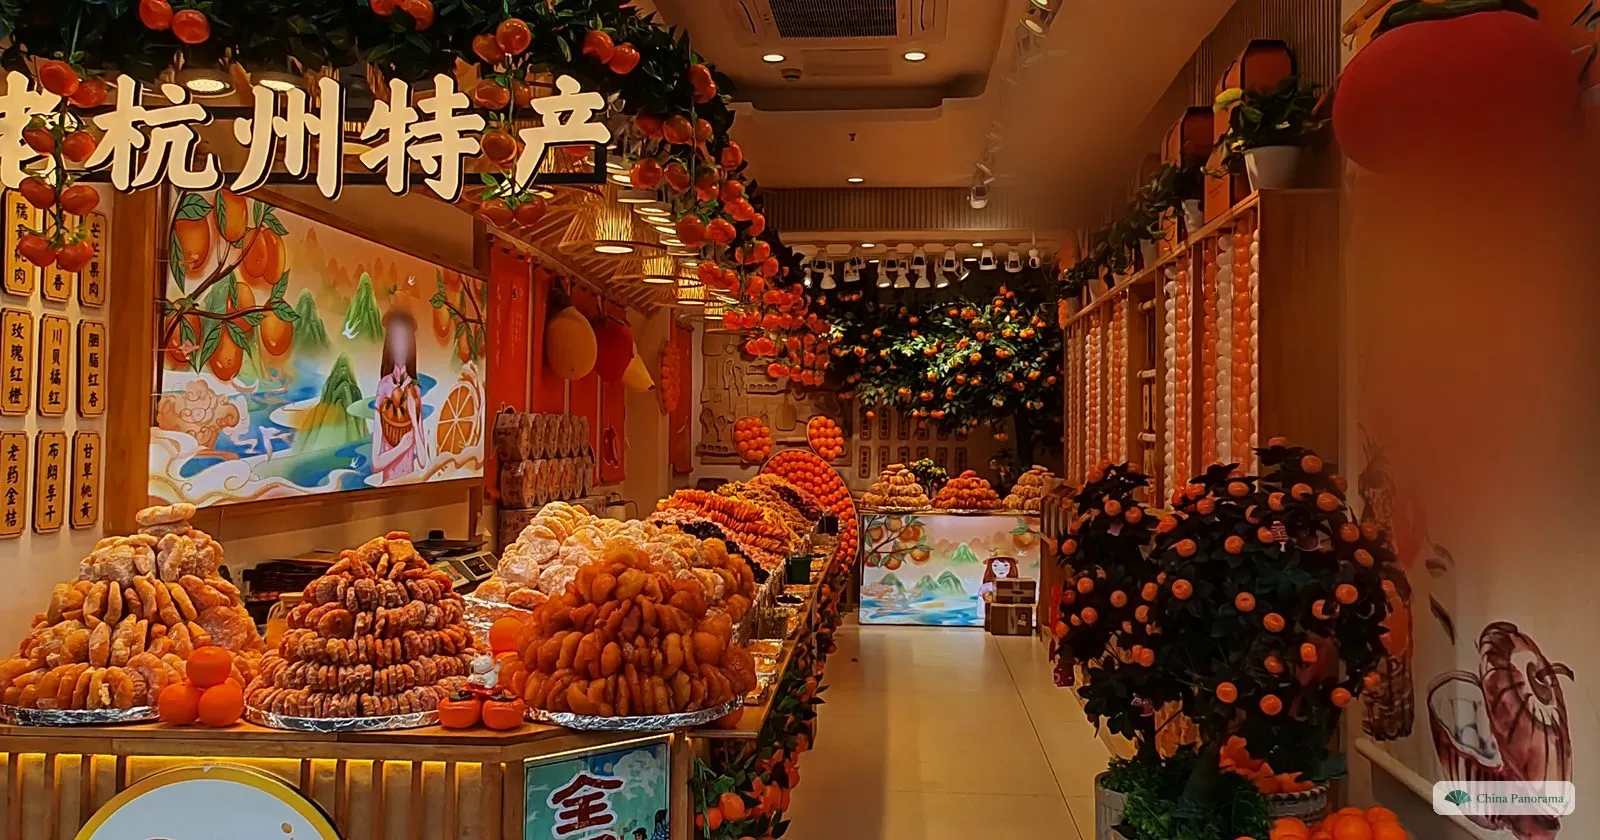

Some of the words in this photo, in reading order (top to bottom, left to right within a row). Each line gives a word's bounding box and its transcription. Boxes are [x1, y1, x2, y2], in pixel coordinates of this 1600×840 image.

[8, 323, 25, 404] 玫瑰红橙
[48, 328, 63, 405] 川贝橘红
[88, 333, 99, 407] 胭脂红杏
[5, 443, 20, 527] 老药金桔
[548, 772, 625, 840] 全
